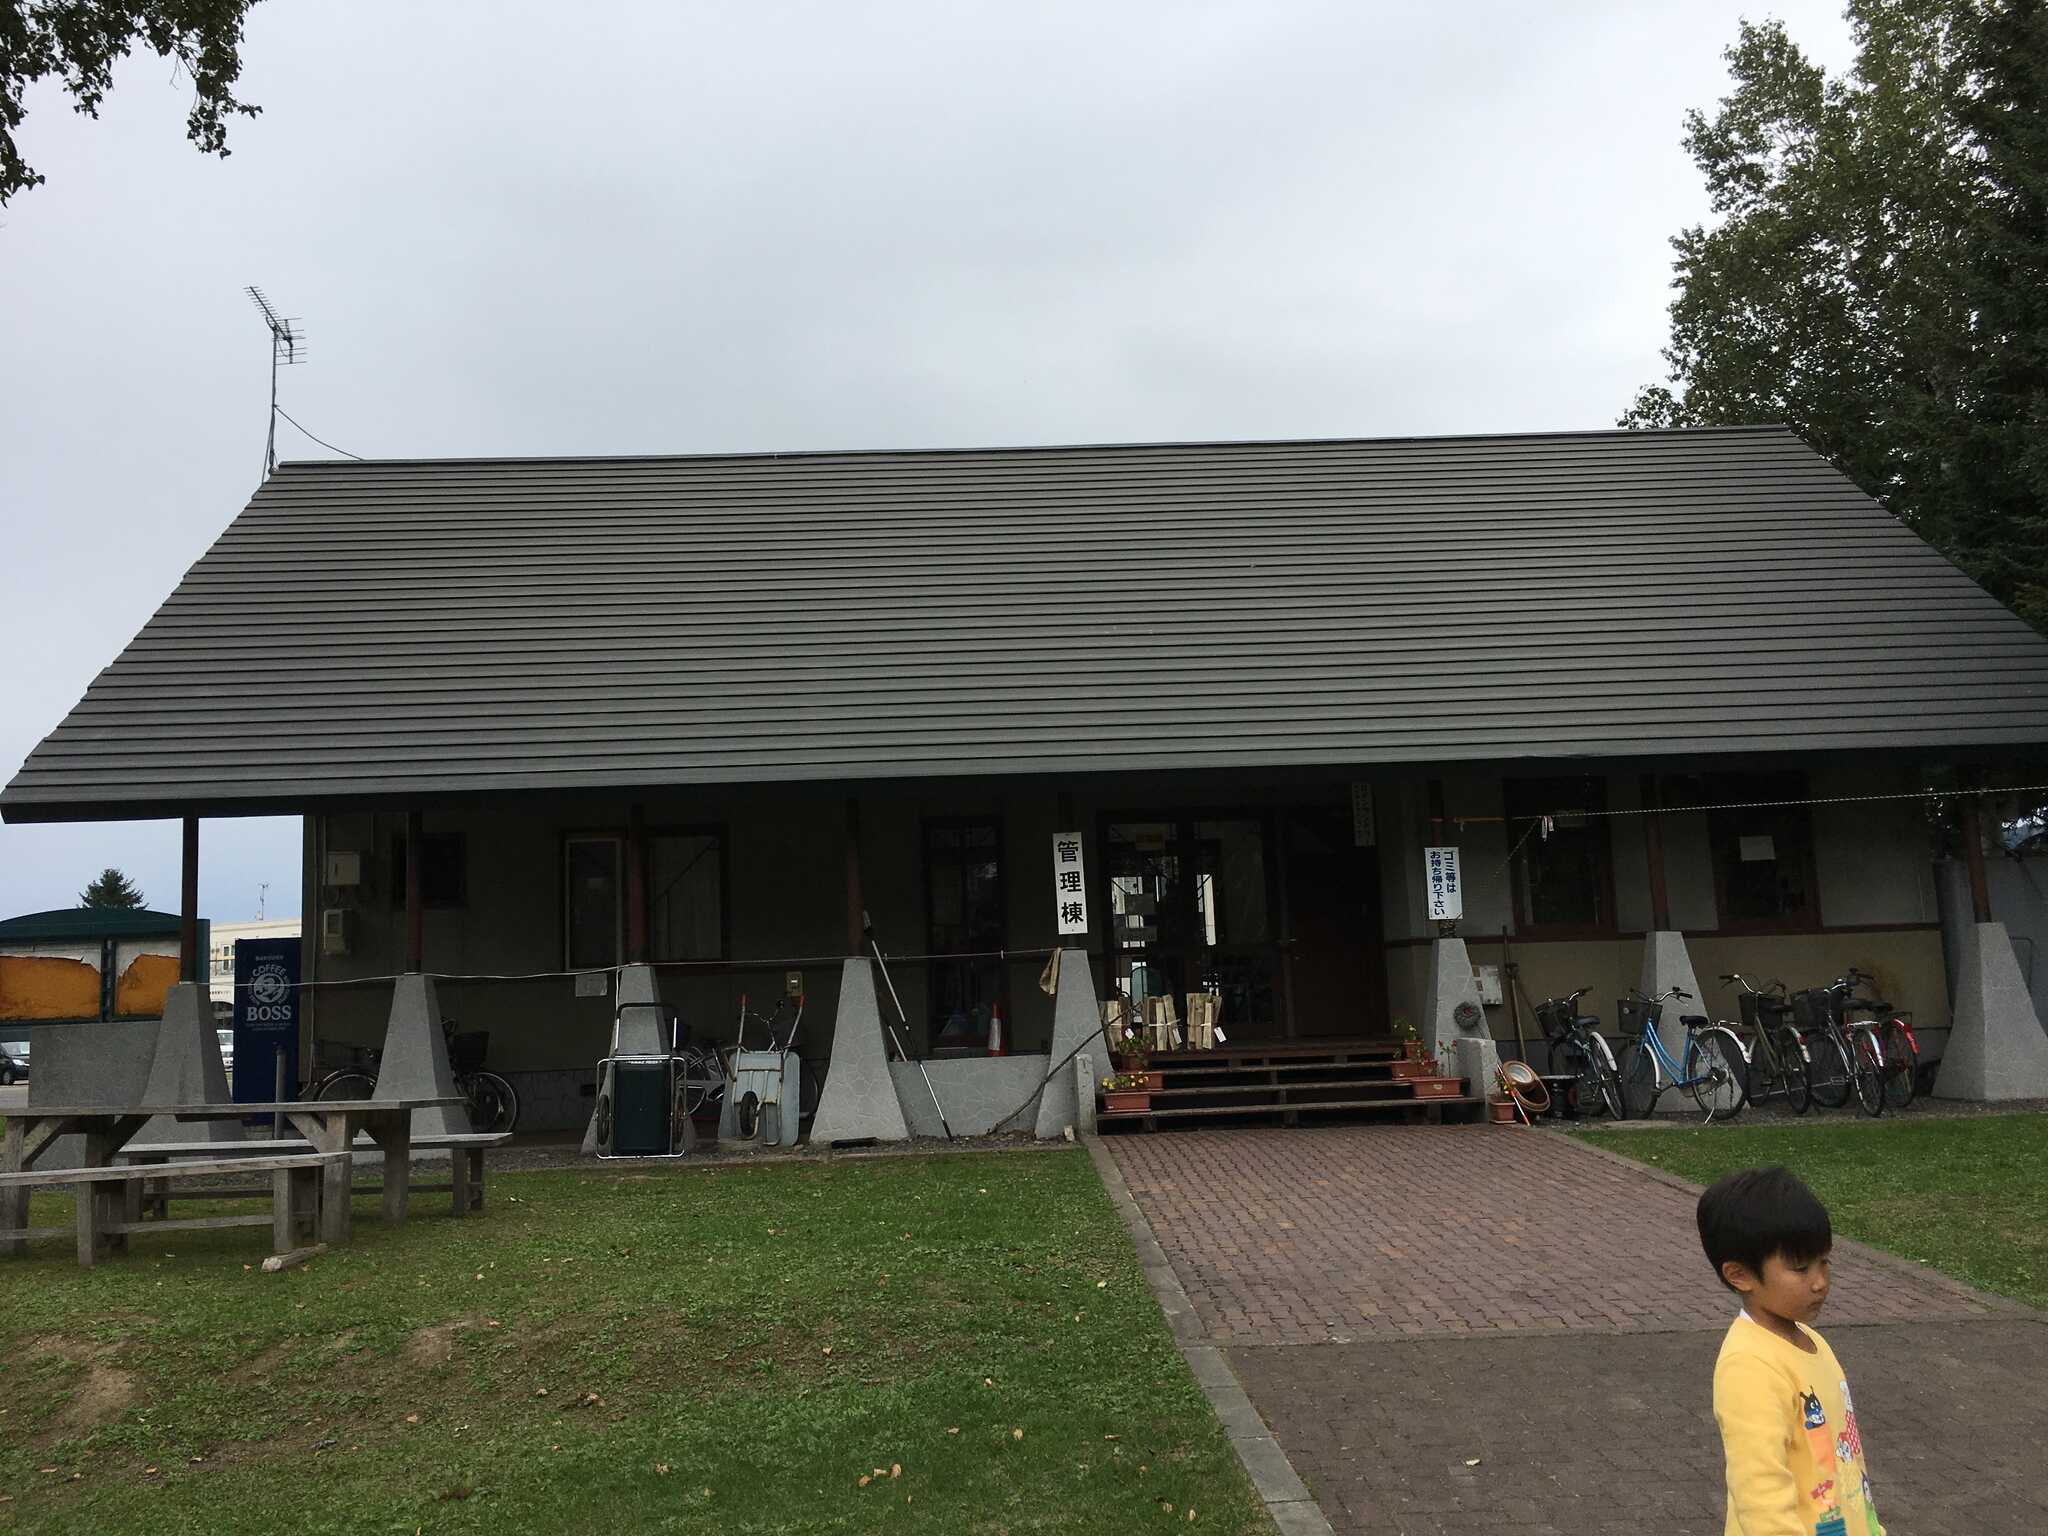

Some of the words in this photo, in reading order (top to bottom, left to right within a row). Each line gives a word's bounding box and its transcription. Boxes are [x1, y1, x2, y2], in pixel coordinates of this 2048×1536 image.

[1057, 840, 1084, 924] 管理棟
[1430, 850, 1446, 916] お持ち帰り下さい
[1443, 850, 1457, 894] ゴミ等は
[252, 963, 287, 977] COFFEE
[246, 1005, 292, 1021] BOSS
